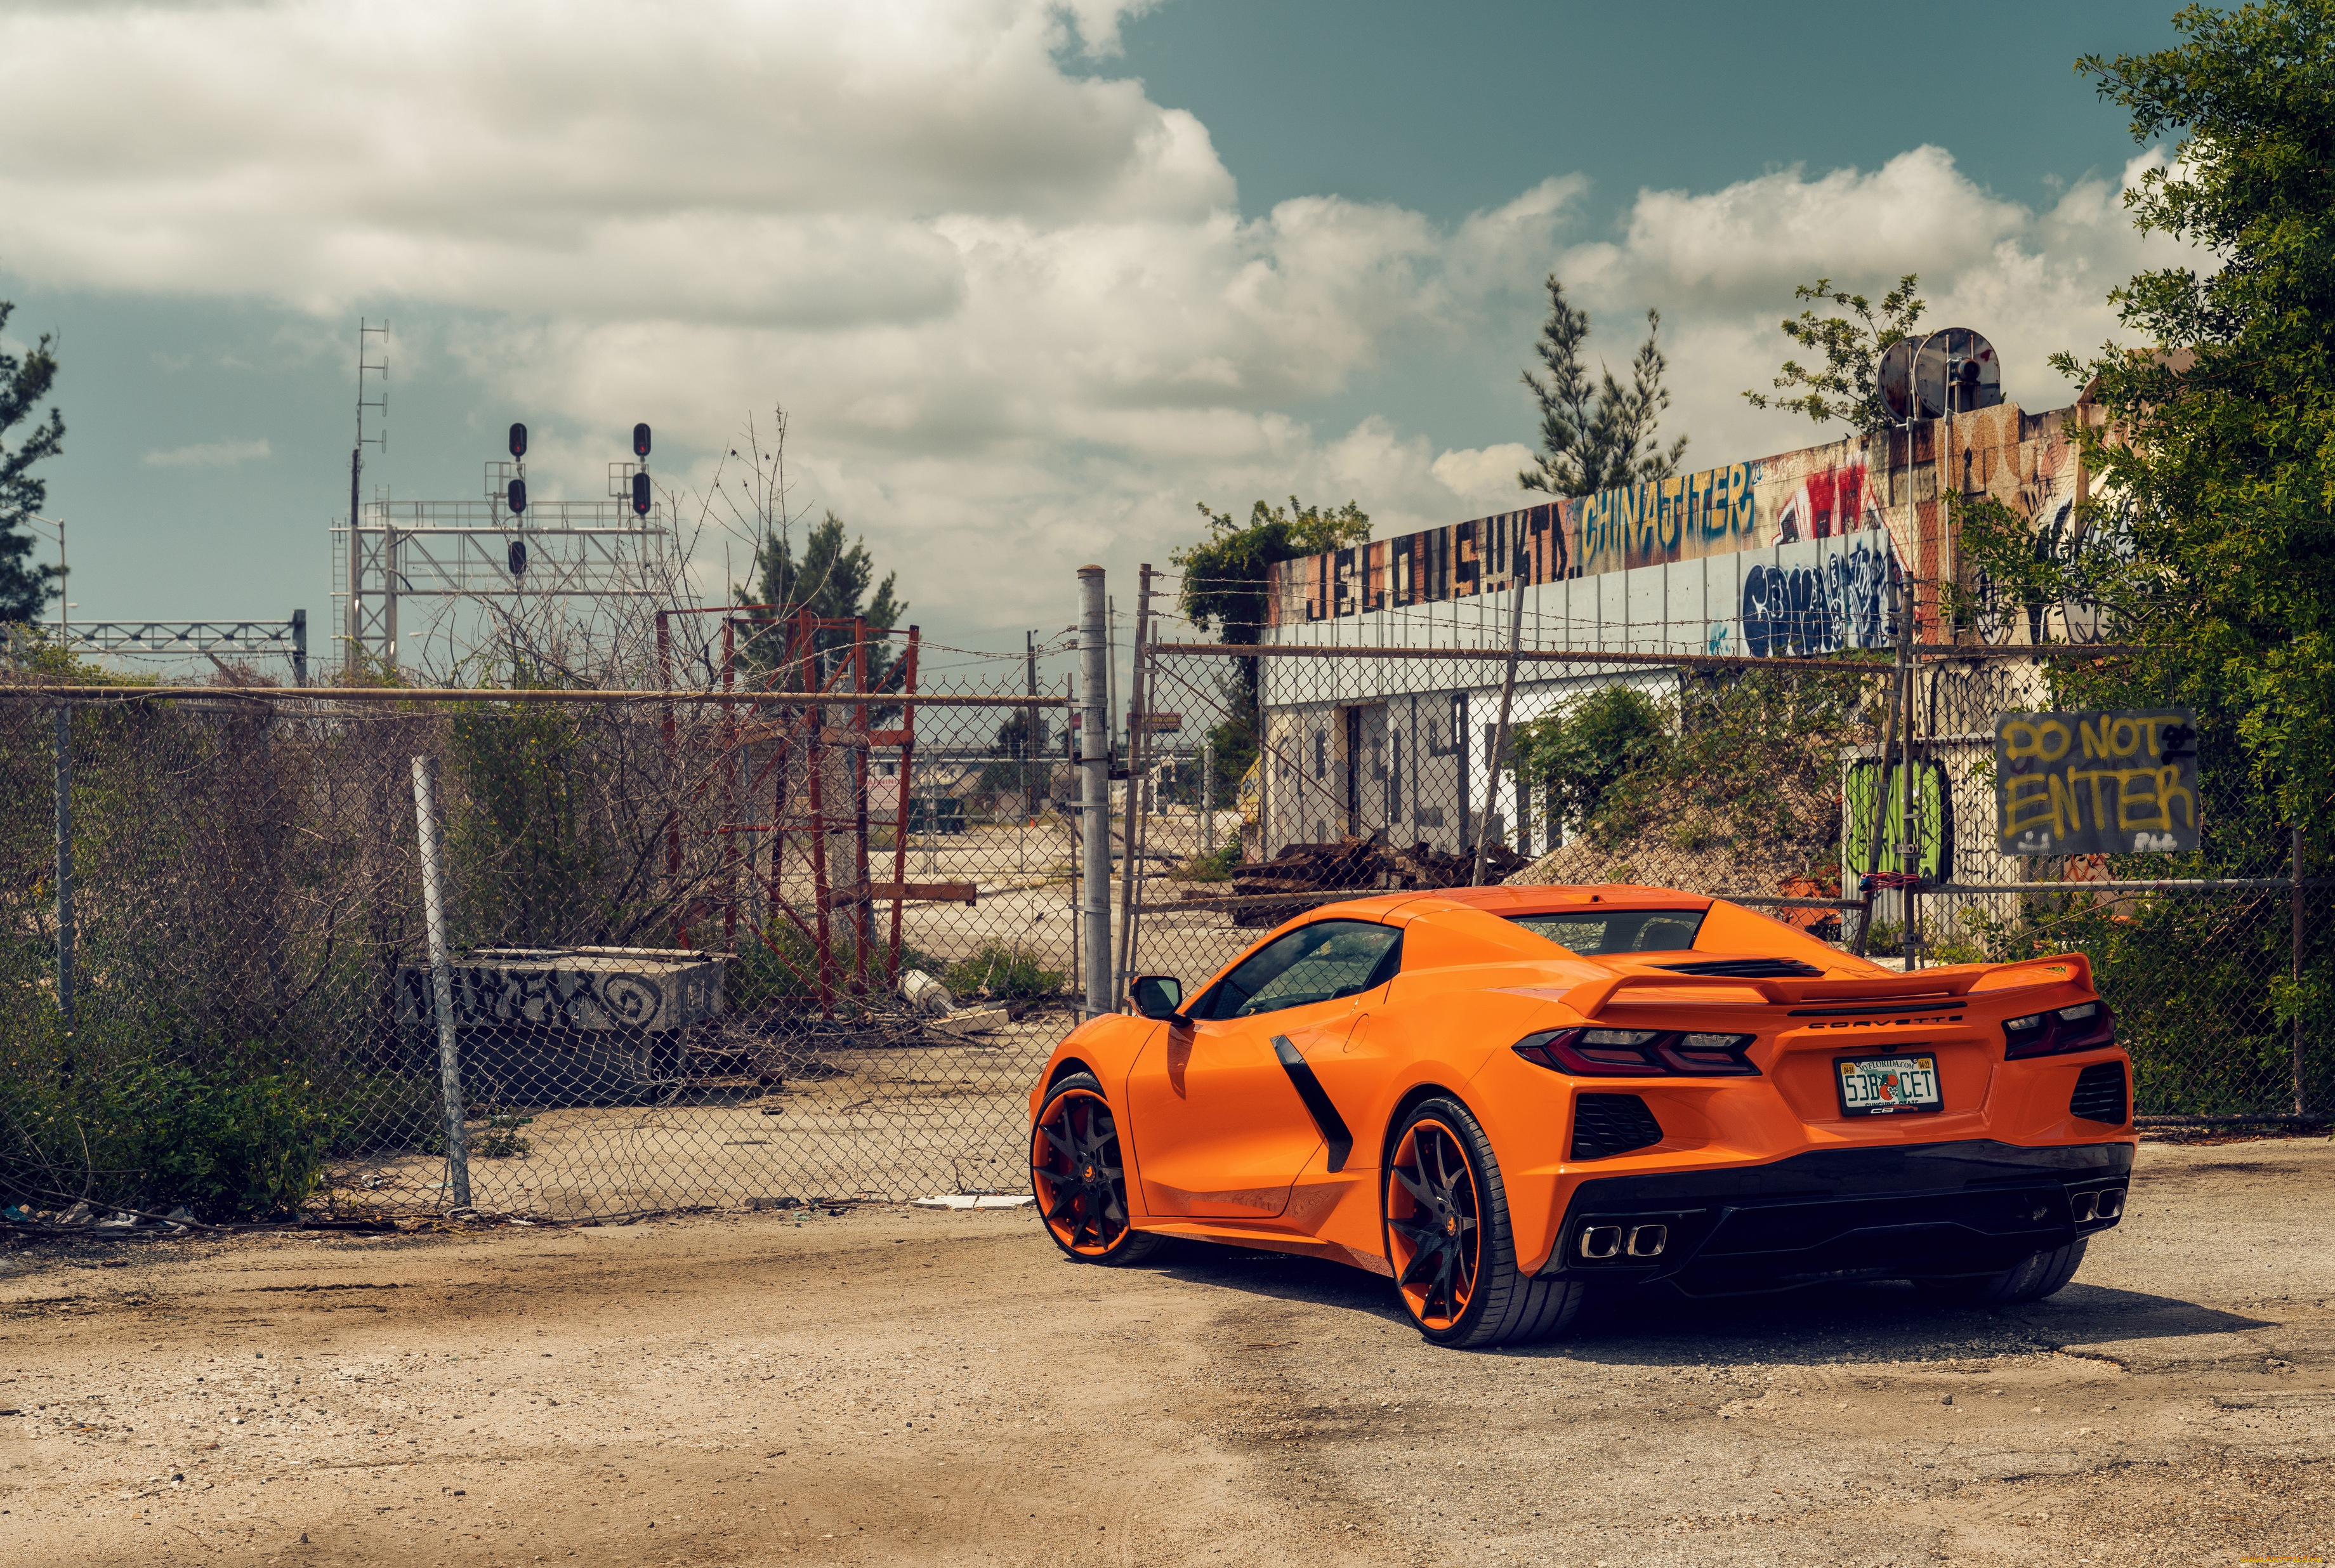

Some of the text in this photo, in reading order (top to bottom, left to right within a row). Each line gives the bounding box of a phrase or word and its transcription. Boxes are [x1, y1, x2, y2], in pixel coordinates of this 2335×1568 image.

[2002, 715, 2185, 761] DO NOT
[2004, 763, 2194, 840] ENTER
[1808, 1015, 1964, 1029] CORVETTE
[1900, 1070, 1931, 1098] CET
